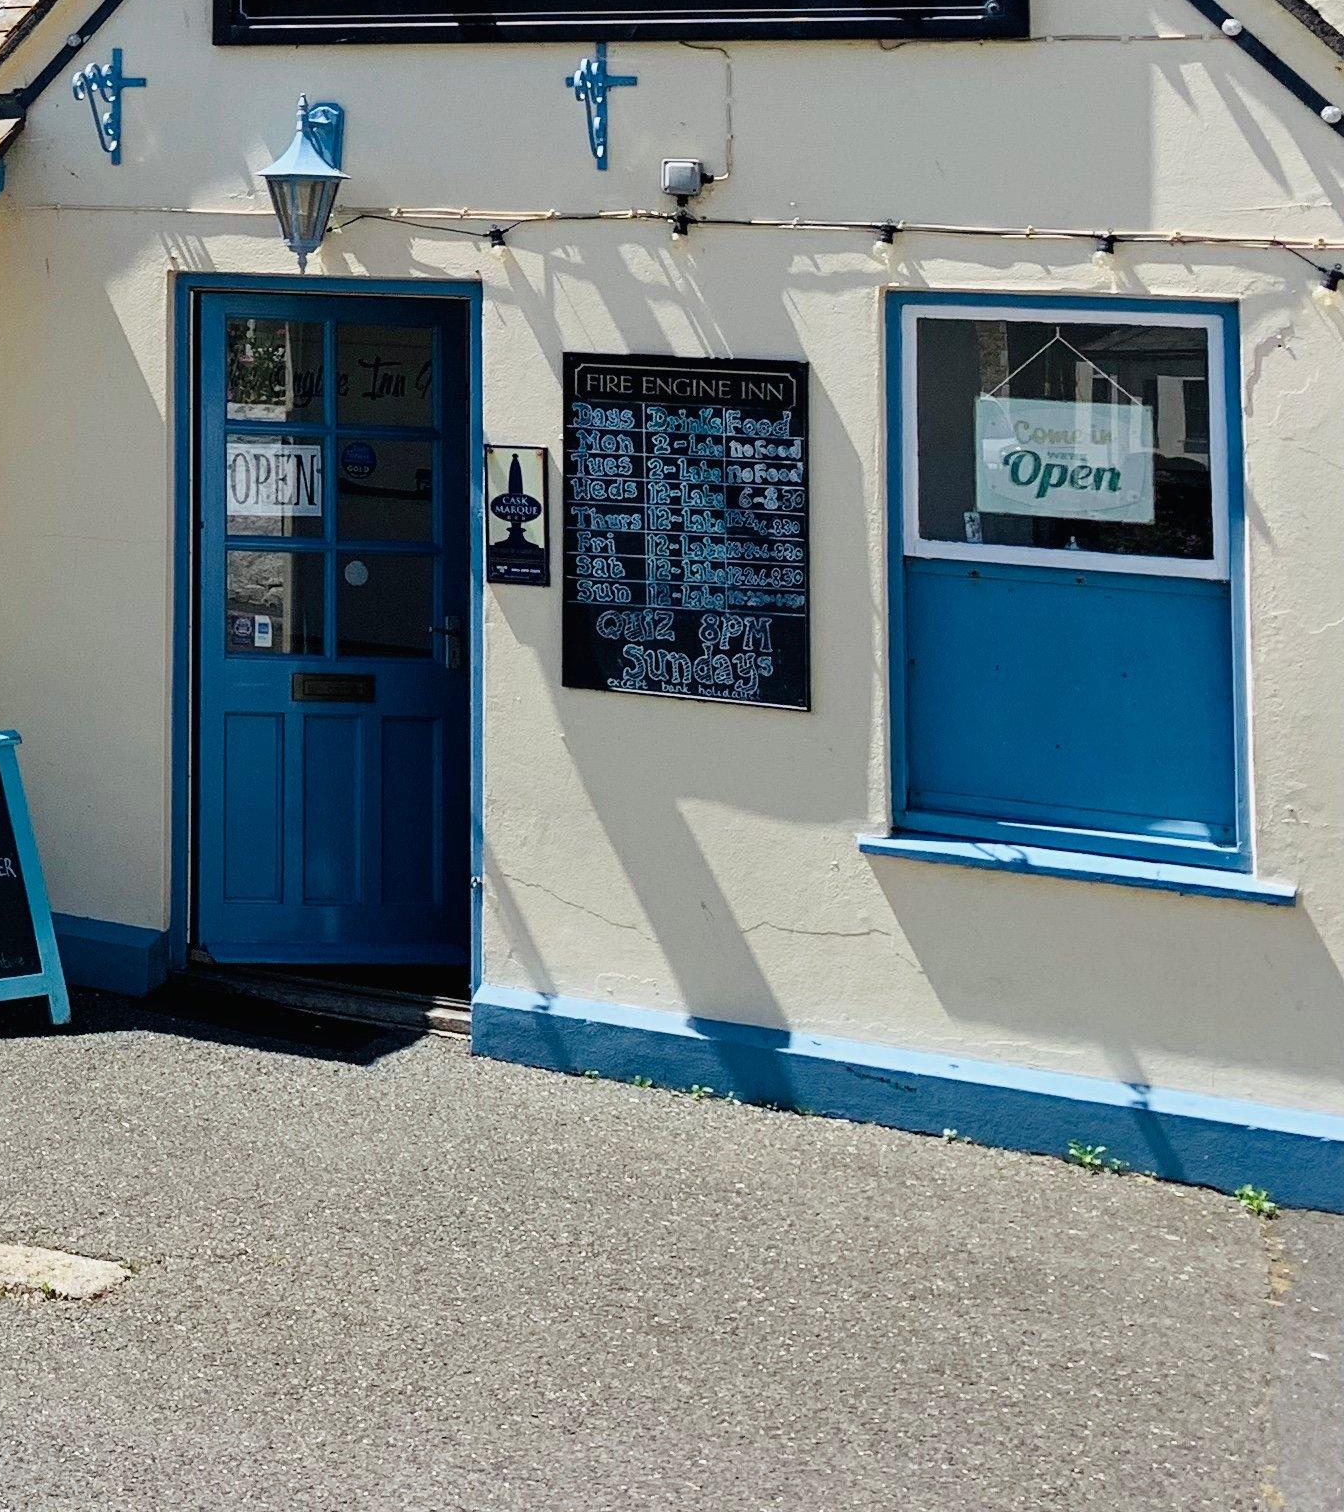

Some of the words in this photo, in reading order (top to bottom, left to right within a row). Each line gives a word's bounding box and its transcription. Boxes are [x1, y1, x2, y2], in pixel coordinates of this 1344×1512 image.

[587, 374, 633, 393] FIRE
[642, 376, 732, 399] ENGINE
[741, 380, 784, 401] INN
[572, 402, 635, 428] Days
[647, 406, 723, 434] Drinks
[726, 410, 791, 438] Food
[576, 430, 634, 454] Mon
[1014, 420, 1082, 445] Come
[346, 464, 370, 473] GOLD
[572, 453, 633, 477] Tues
[1003, 450, 1122, 499] Open
[230, 451, 318, 507] OPEN
[571, 478, 638, 500] Weds
[495, 506, 538, 516] MARQUE
[502, 496, 529, 505] CASK
[571, 506, 642, 531] Thurs
[577, 531, 616, 554] Fri
[576, 555, 626, 578] Sat
[577, 579, 632, 603] Sun
[623, 642, 774, 693] Sundays
[662, 681, 691, 694] bank
